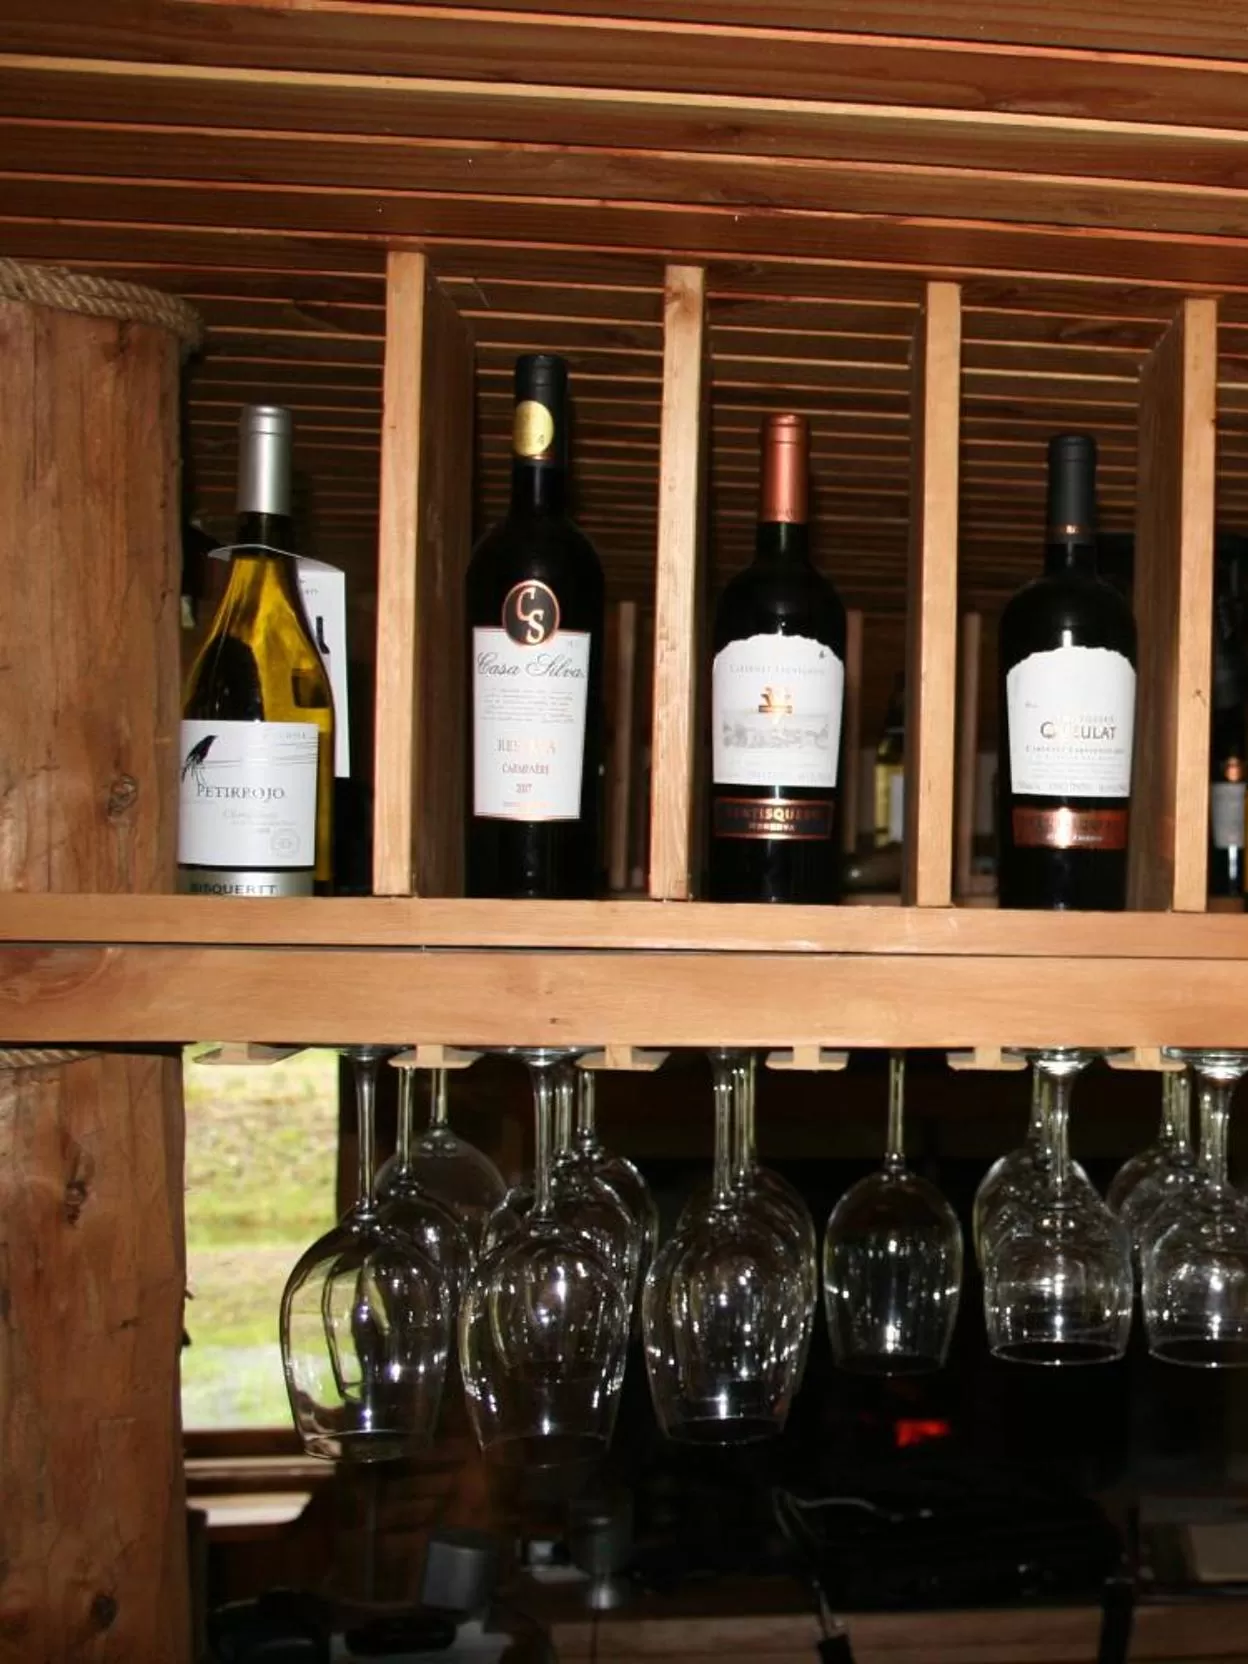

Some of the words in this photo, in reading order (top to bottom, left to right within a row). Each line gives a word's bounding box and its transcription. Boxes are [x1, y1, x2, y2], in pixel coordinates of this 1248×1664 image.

[477, 652, 520, 676] Casa
[526, 653, 585, 679] Silva
[196, 783, 285, 803] PETIRROJO
